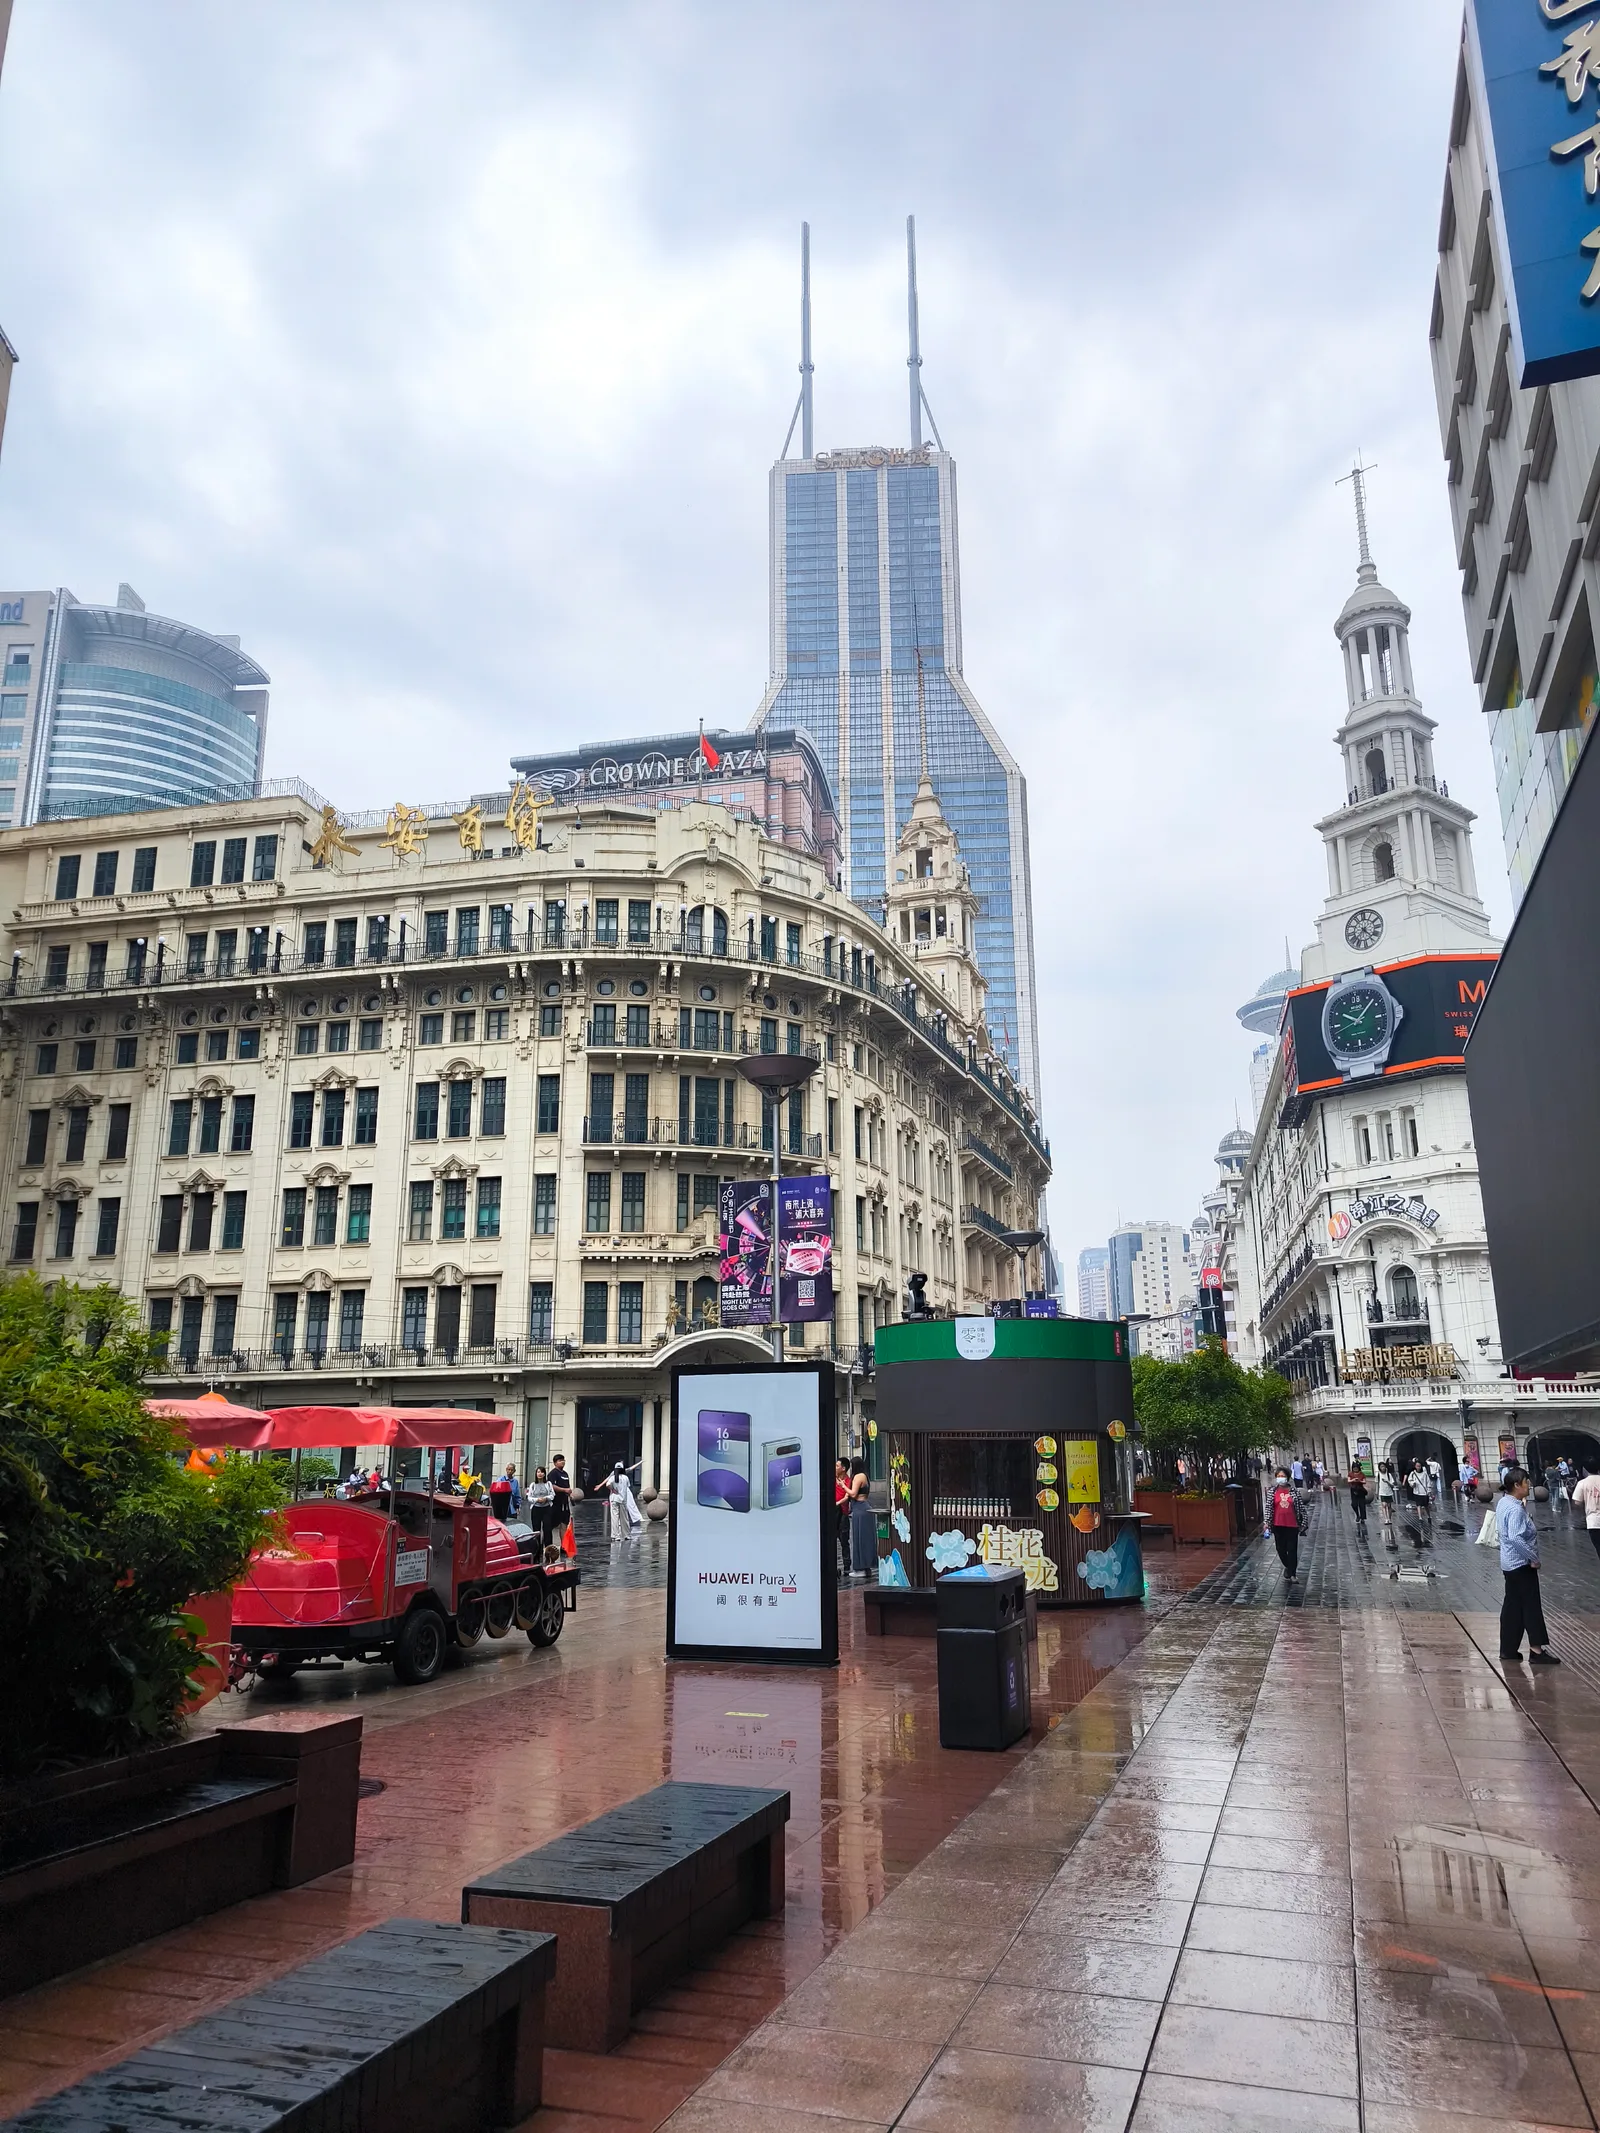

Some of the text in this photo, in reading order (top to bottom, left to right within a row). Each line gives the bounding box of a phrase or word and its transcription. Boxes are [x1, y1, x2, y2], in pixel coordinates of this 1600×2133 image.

[590, 758, 684, 786] CROWNE
[1350, 1194, 1427, 1221] 锦江之星
[1340, 1343, 1454, 1369] 上海时装商店
[1339, 1367, 1456, 1380] SHANGHAI FASHION STORE
[716, 1427, 729, 1439] 16
[716, 1440, 729, 1451] 10
[780, 1468, 790, 1477] 16
[780, 1478, 790, 1486] 10
[980, 1526, 1040, 1560] 桂花
[699, 1573, 797, 1585] HUAWEI Pura X
[717, 1595, 778, 1606] 阔 很有型
